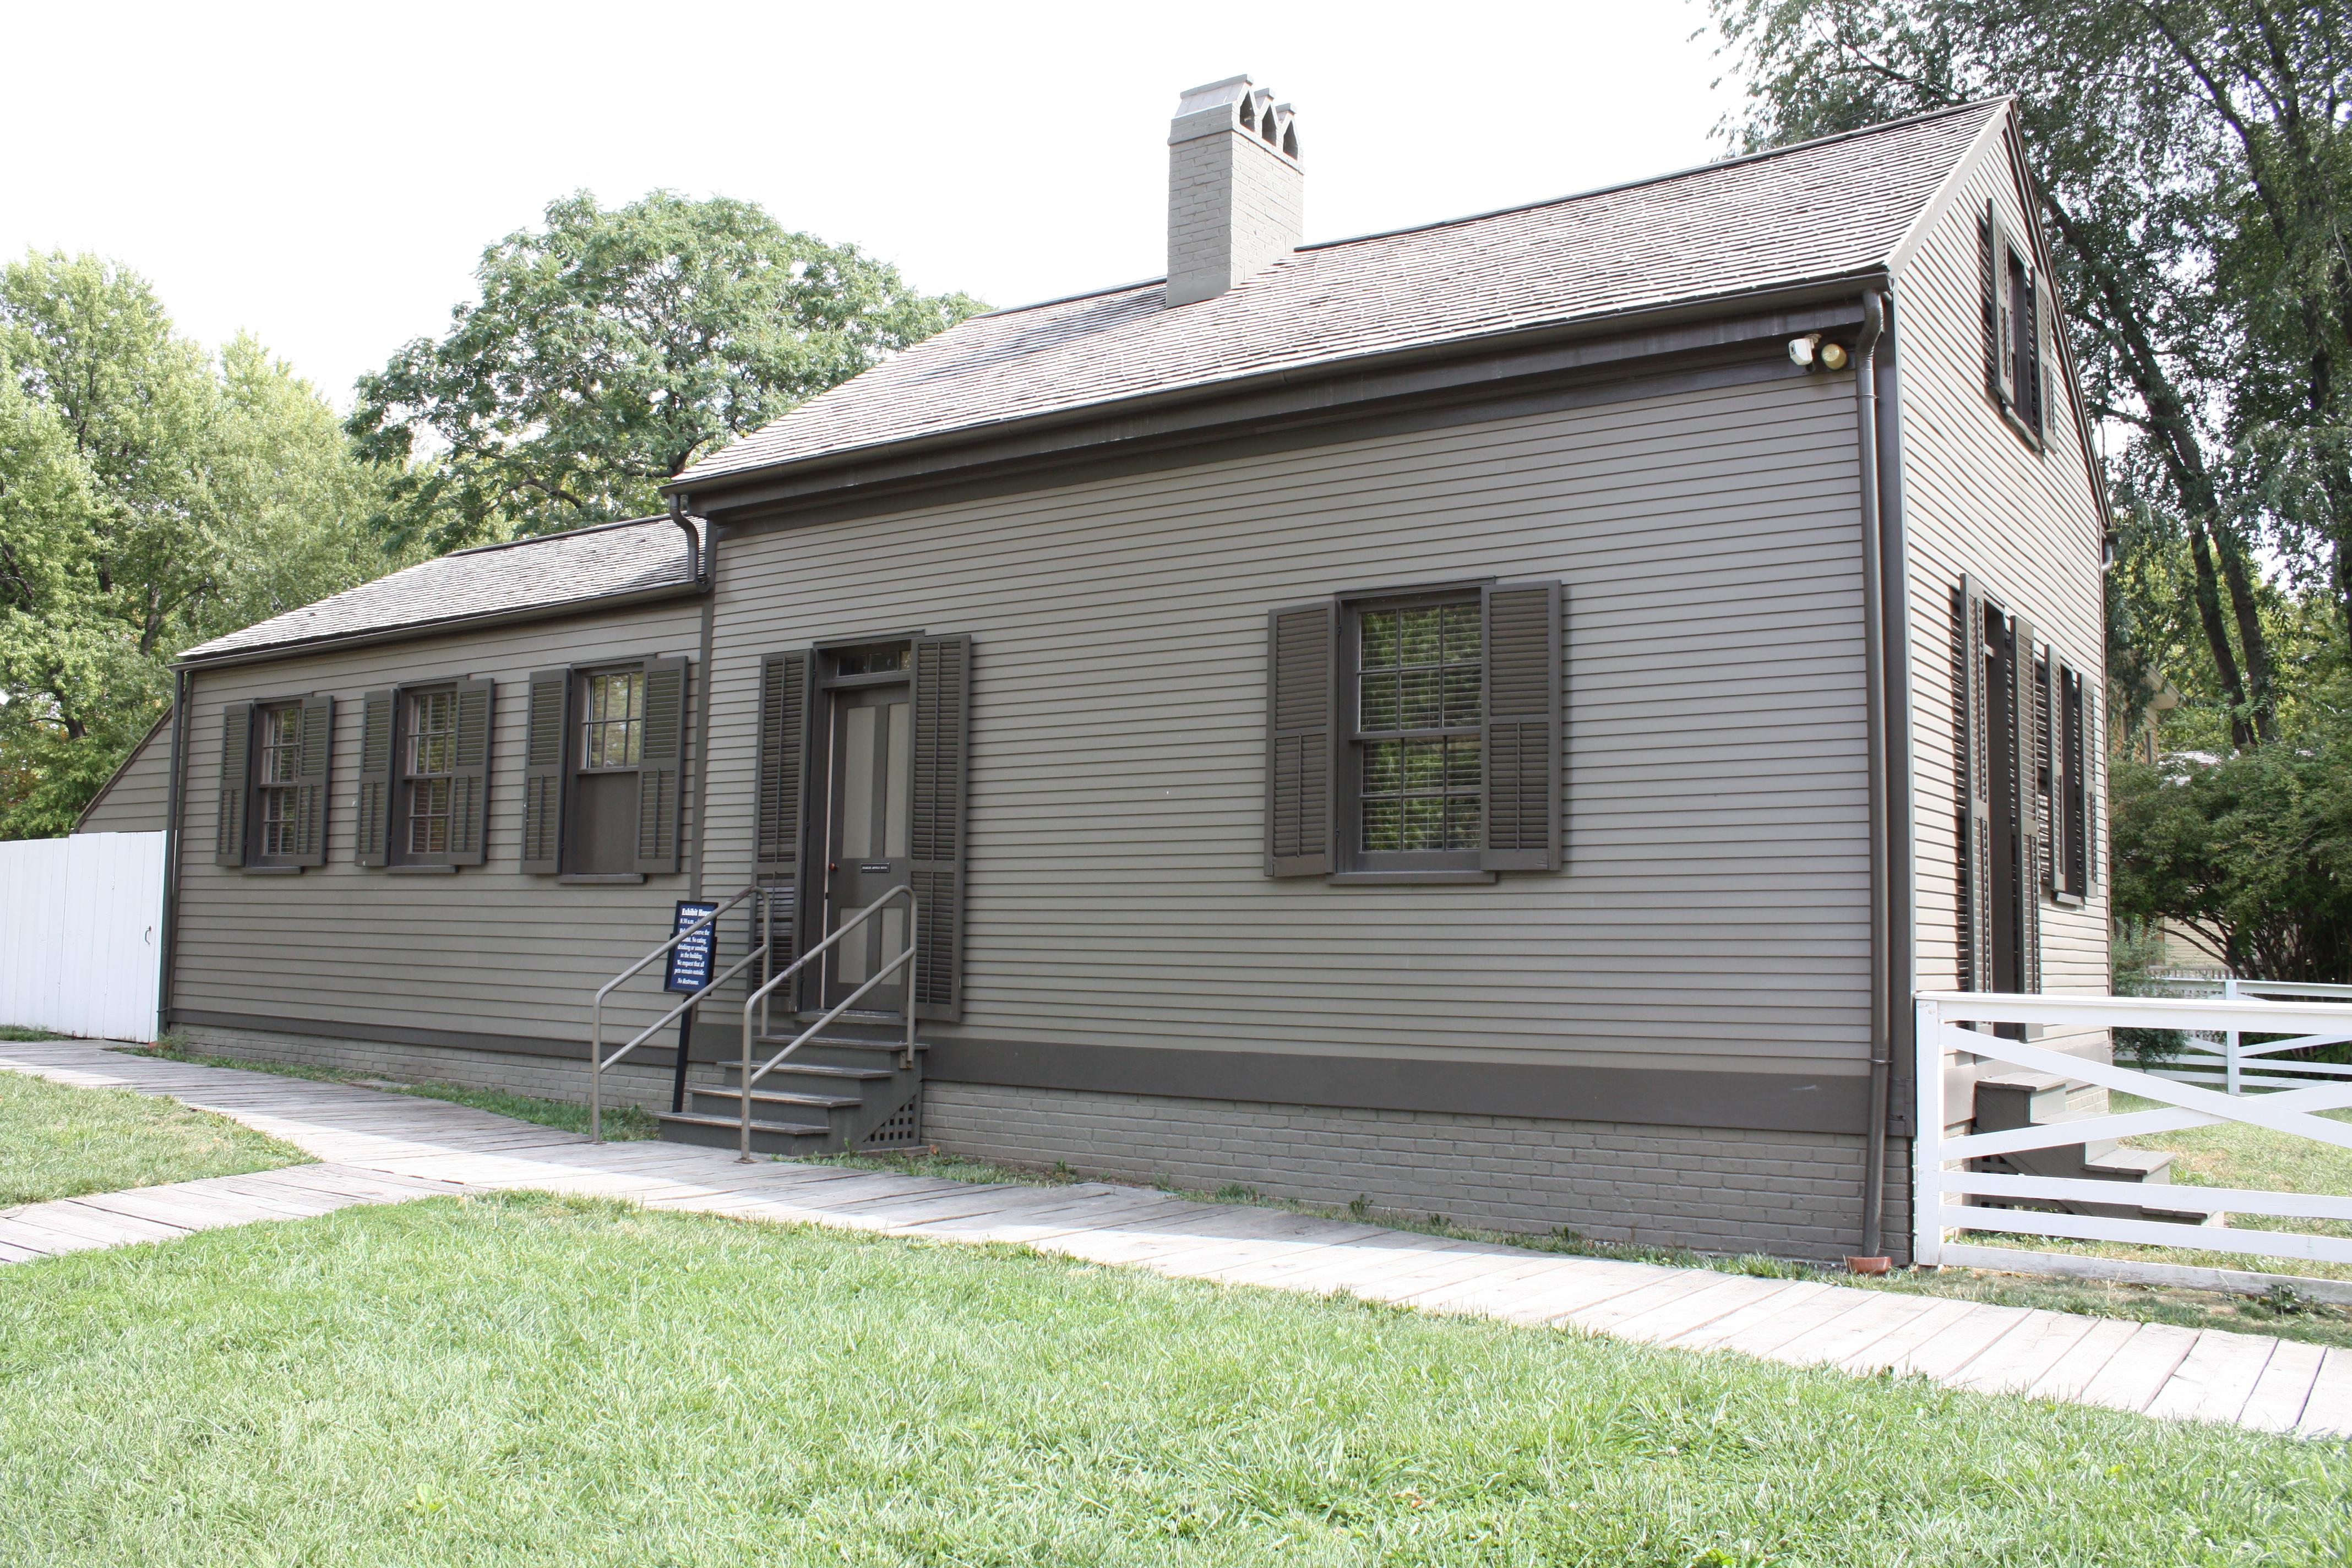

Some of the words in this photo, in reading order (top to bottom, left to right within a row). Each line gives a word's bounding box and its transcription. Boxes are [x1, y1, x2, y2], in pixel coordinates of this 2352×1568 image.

[698, 908, 712, 917] Hour
[678, 943, 690, 951] drinking
[694, 945, 708, 953] smoking
